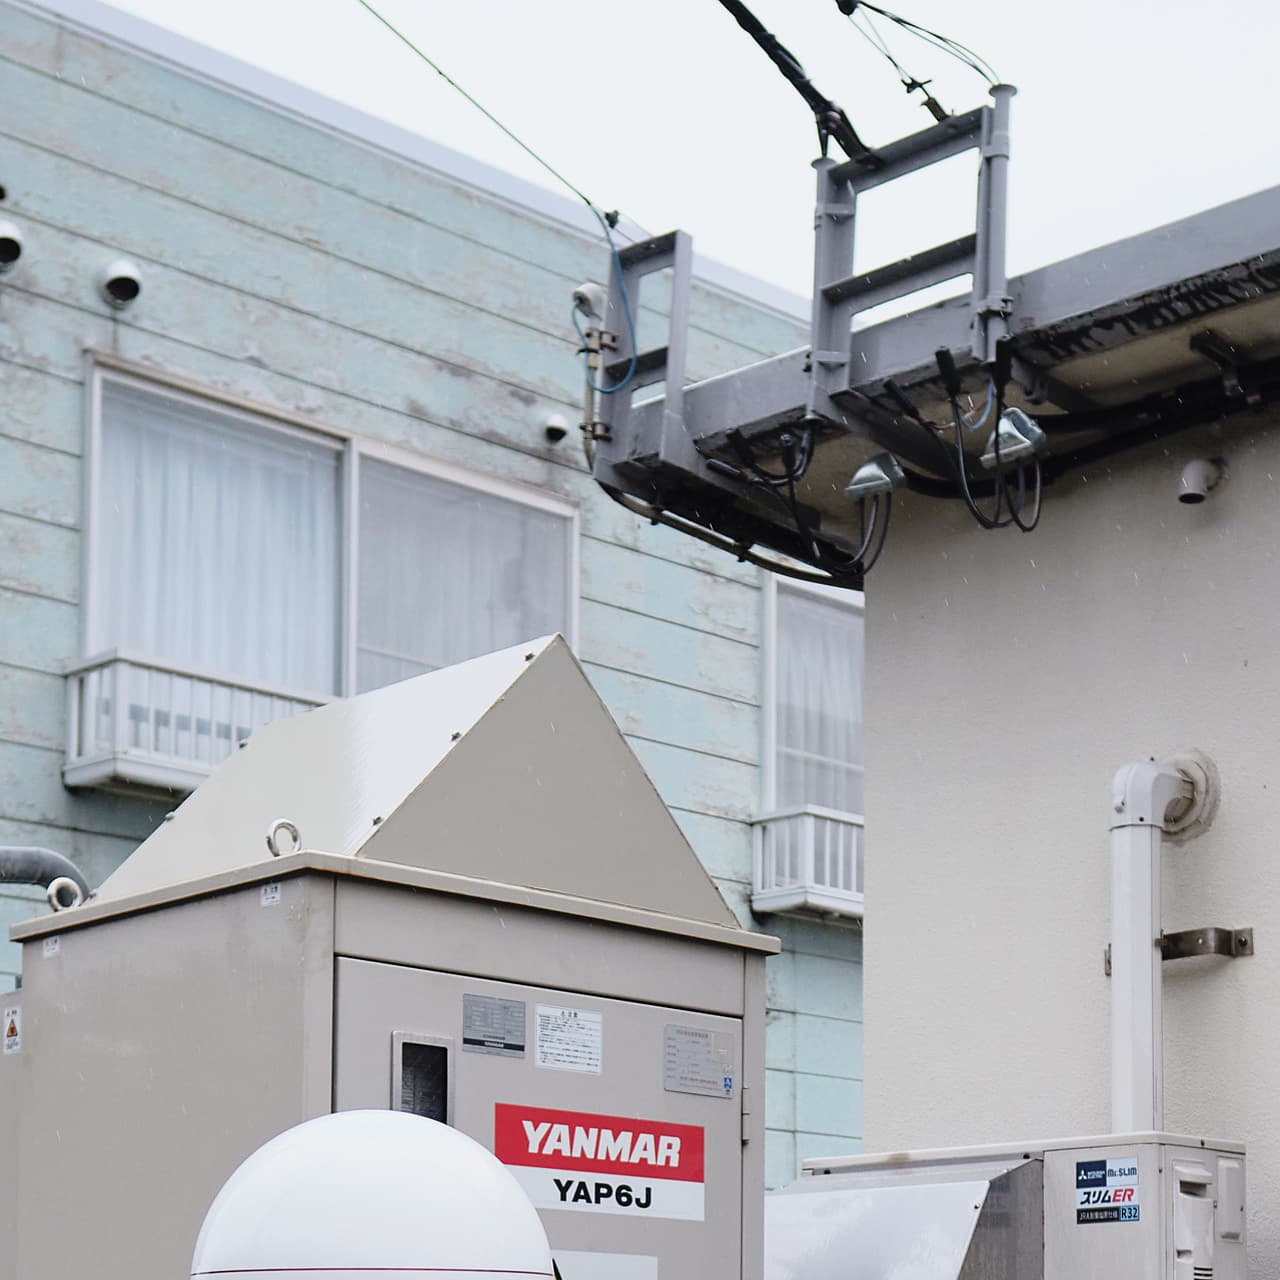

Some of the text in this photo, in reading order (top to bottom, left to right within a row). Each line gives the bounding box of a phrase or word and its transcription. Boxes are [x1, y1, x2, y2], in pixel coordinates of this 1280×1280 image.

[521, 1120, 682, 1168] YANMAR
[553, 1178, 653, 1210] YAP6J
[1080, 1188, 1134, 1205] スリムER
[1121, 1207, 1138, 1219] R32
